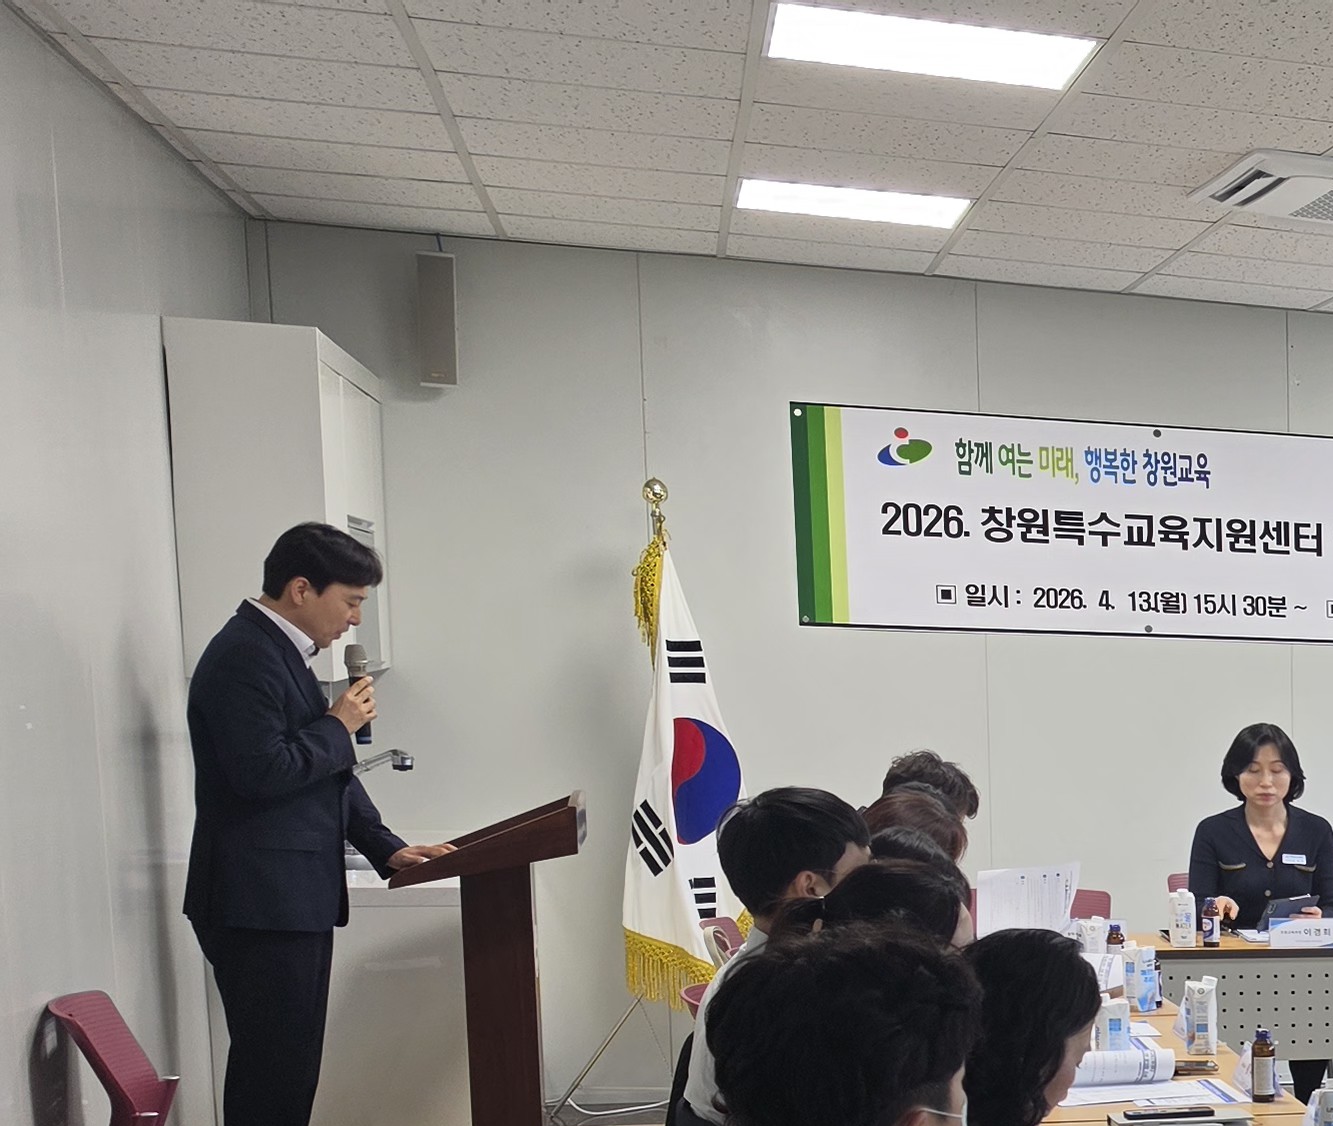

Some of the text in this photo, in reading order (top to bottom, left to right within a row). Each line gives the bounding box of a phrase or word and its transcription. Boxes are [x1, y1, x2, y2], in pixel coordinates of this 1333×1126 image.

[954, 437, 1212, 489] 함께 여는 미래, 행복한 창원교육
[881, 501, 970, 538] 2026.
[980, 505, 1323, 557] 창원특수교육지원센터
[965, 583, 1009, 608] 일시
[1033, 586, 1087, 609] 2026.
[1098, 589, 1115, 611] 4.
[1193, 593, 1236, 616] 15시
[1242, 595, 1287, 618] 30분
